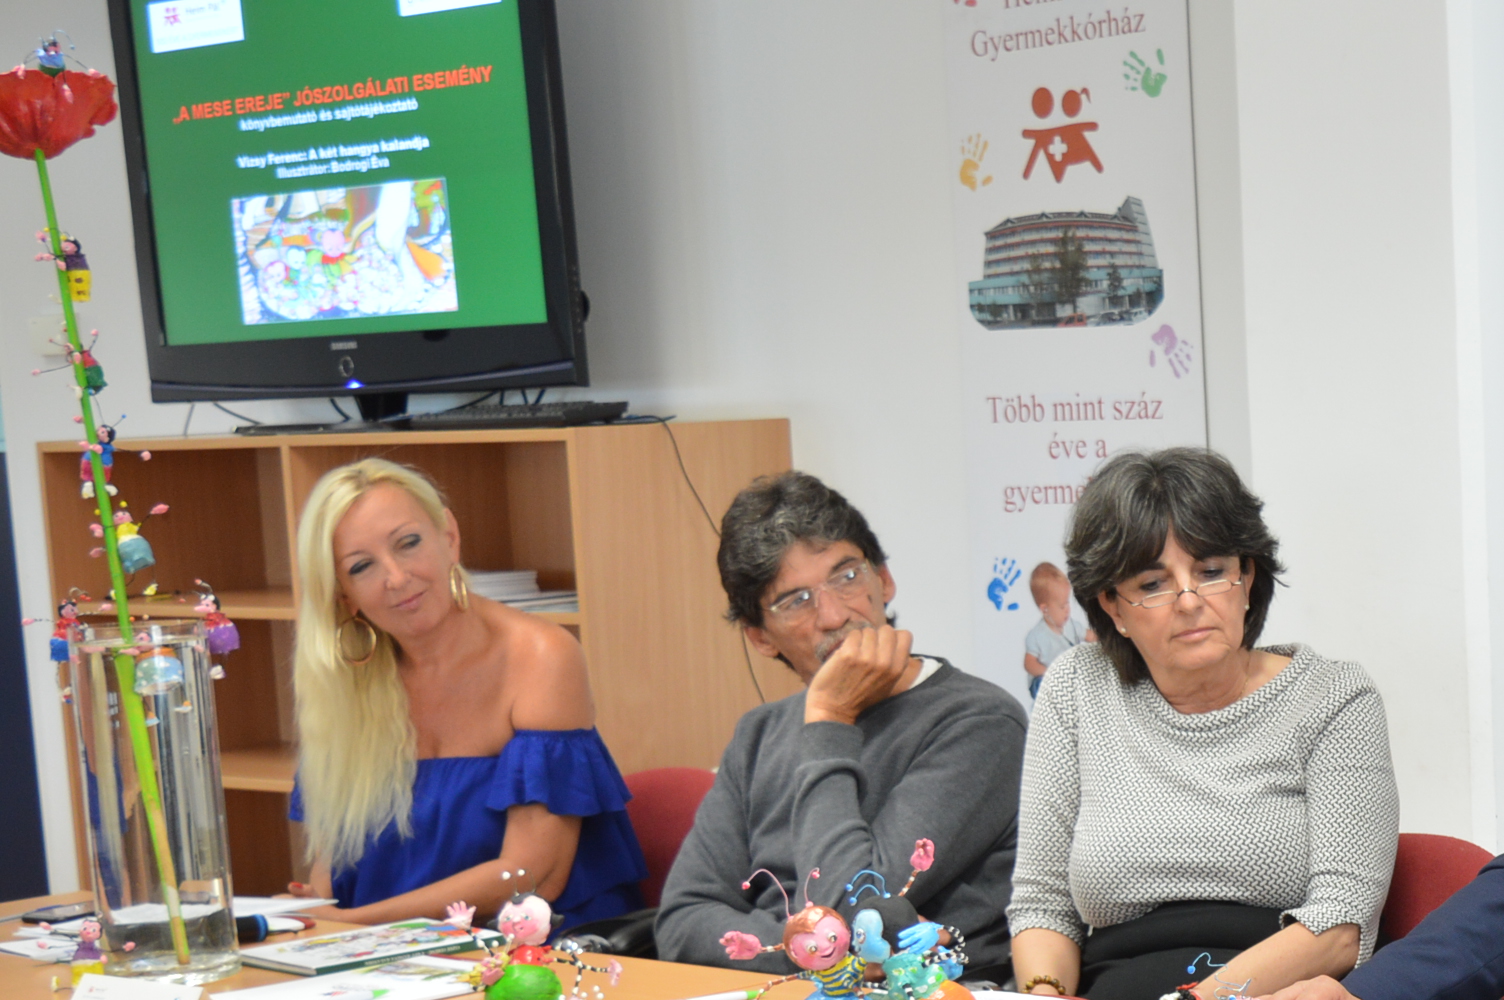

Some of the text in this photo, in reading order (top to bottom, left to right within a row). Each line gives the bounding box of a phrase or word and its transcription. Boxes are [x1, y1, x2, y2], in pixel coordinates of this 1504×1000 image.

[970, 7, 1147, 62] Gyermekkórház
[191, 100, 233, 119] MESE
[293, 77, 409, 107] JÓSZOLGÁLATI
[413, 64, 493, 92] ESEMÉNY
[236, 154, 267, 168] Vizsy
[308, 147, 318, 161] A
[339, 141, 379, 157] hangya
[380, 134, 430, 151] kalandja
[986, 391, 1164, 424] Több mint száz
[1048, 432, 1108, 459] éve a
[1003, 477, 1094, 513] gyerme
